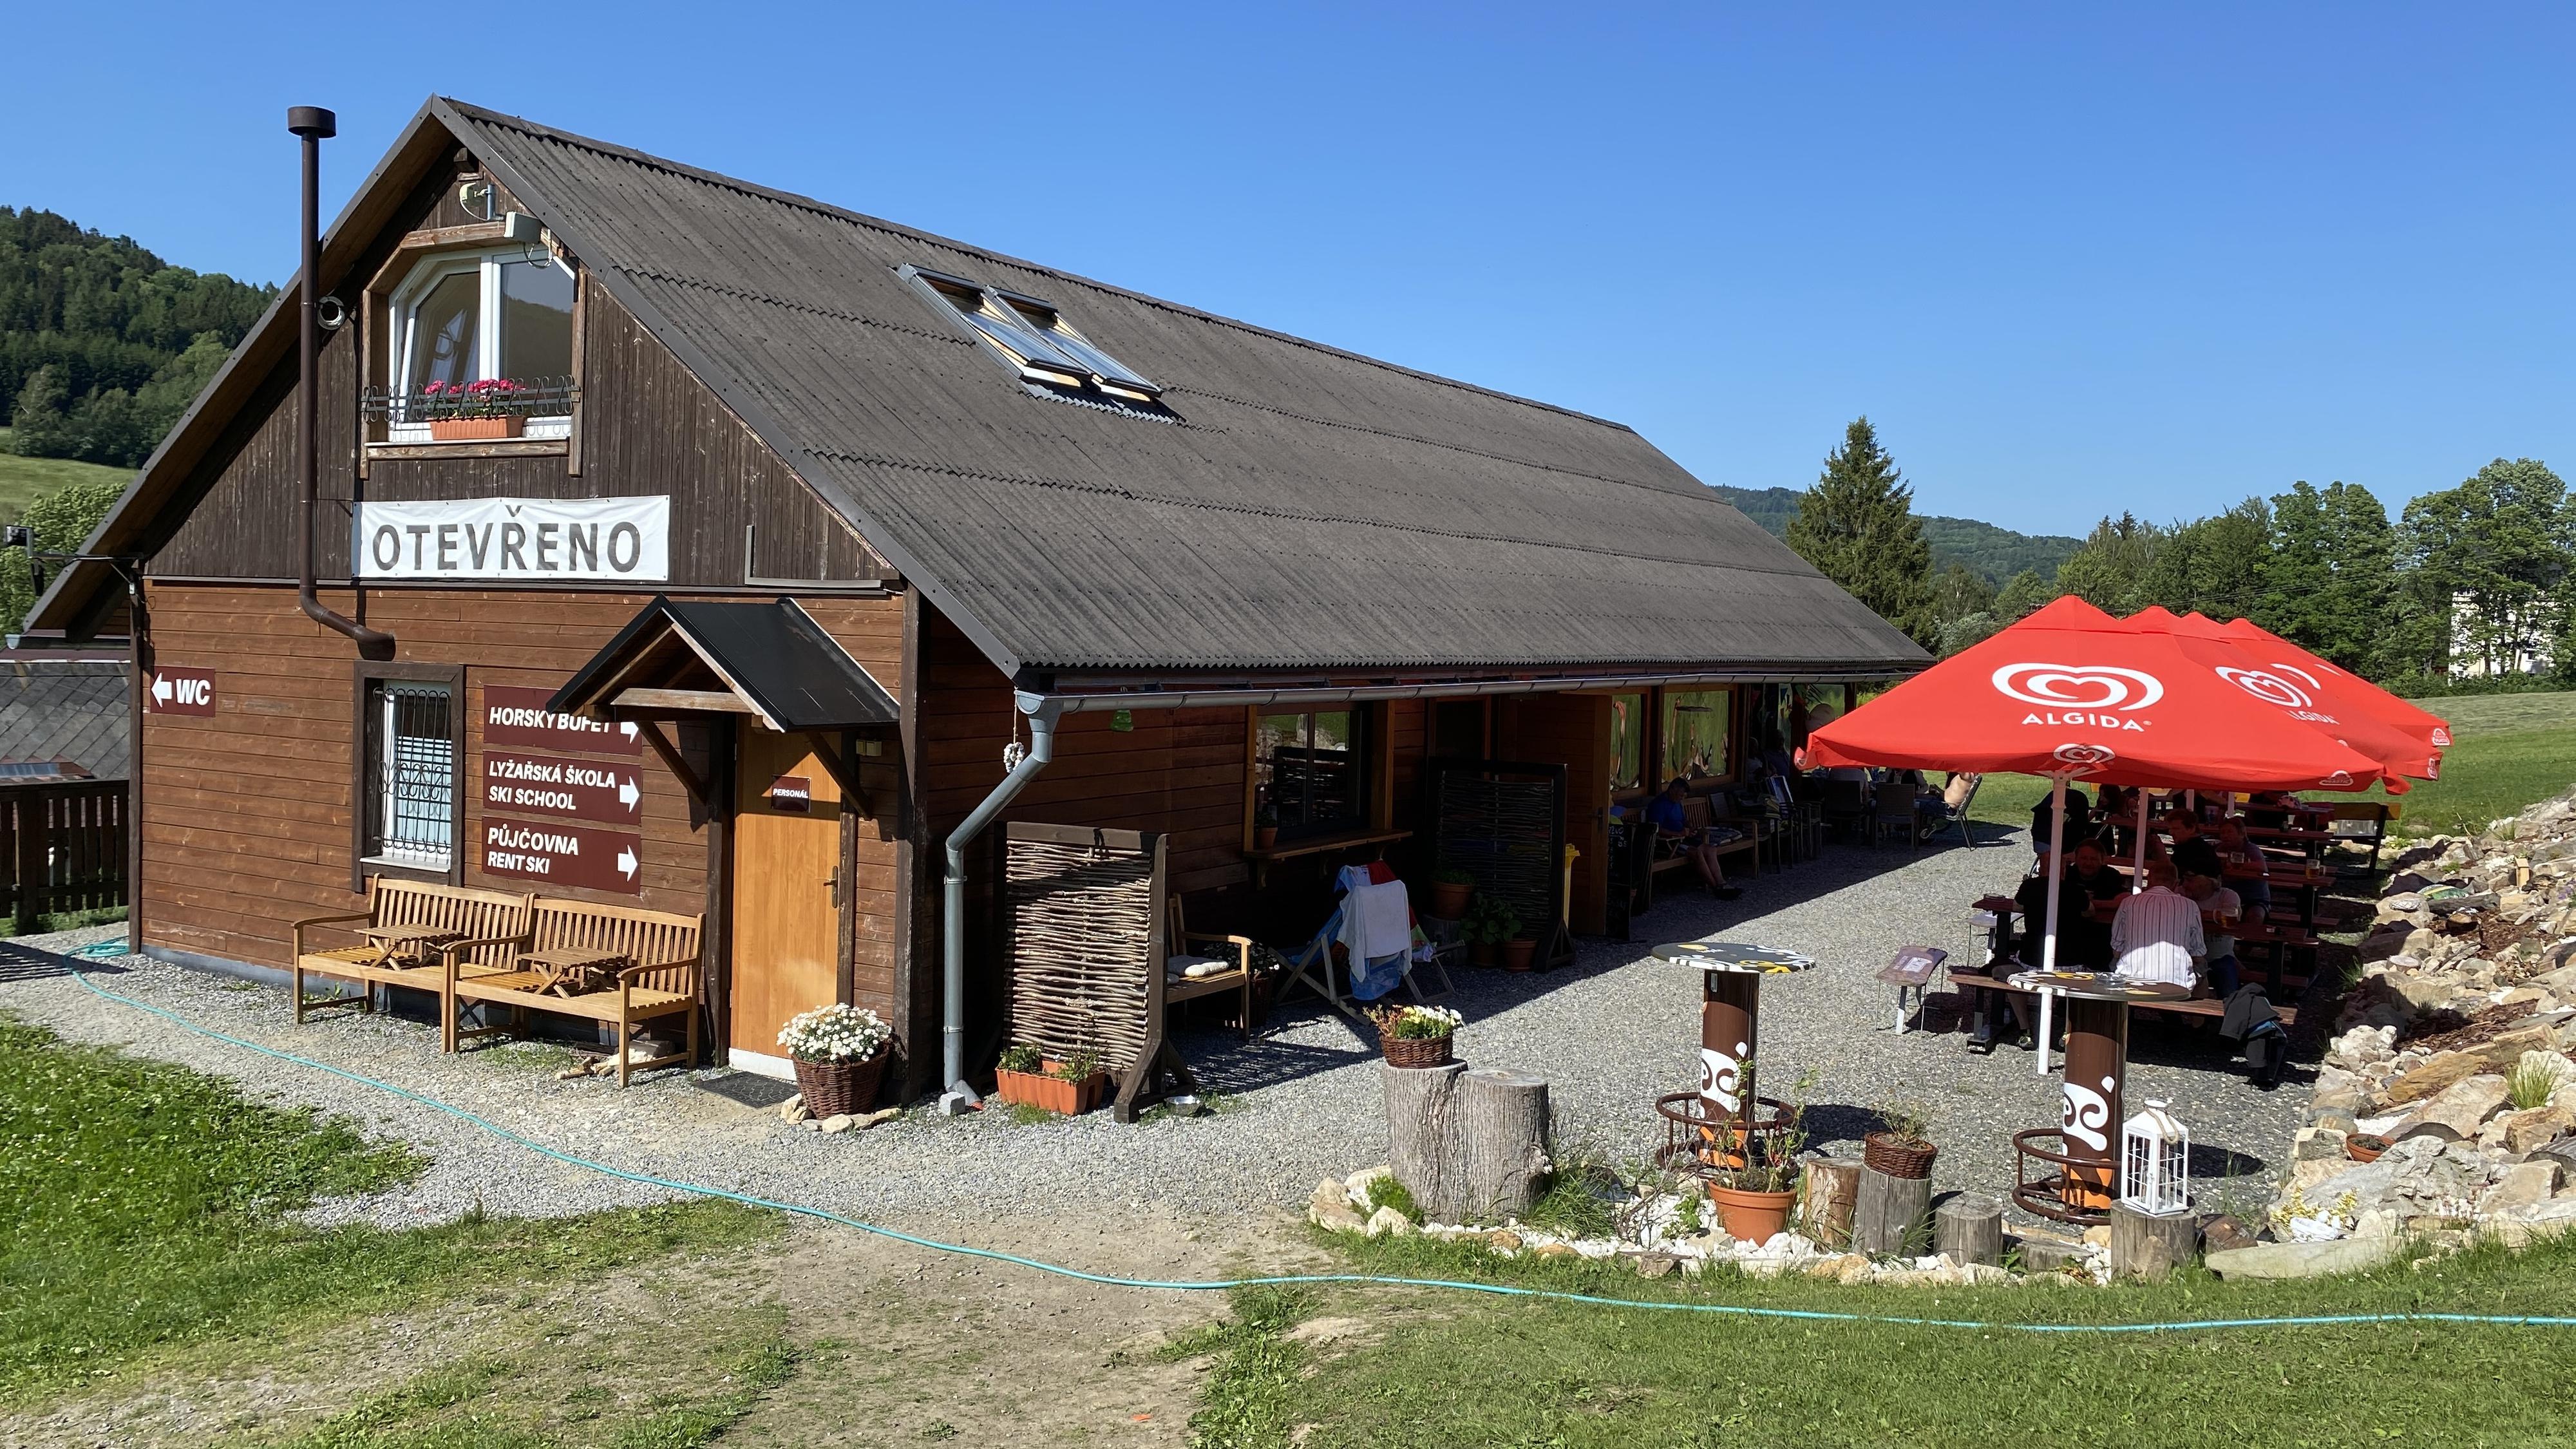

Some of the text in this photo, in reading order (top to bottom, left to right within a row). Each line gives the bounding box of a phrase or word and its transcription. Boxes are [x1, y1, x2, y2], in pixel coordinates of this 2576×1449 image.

[372, 505, 641, 573] OTEVŘENO
[176, 679, 211, 706] WC
[2022, 712, 2145, 732] ALGIDA
[489, 760, 616, 788] LYŽAŘSKÁ ŠKOLA
[489, 785, 576, 810] SKI SCHOOL
[773, 788, 809, 799] PERSONÁL
[488, 824, 578, 855] PŮJČOVNA
[488, 851, 550, 874] RENT SKI
